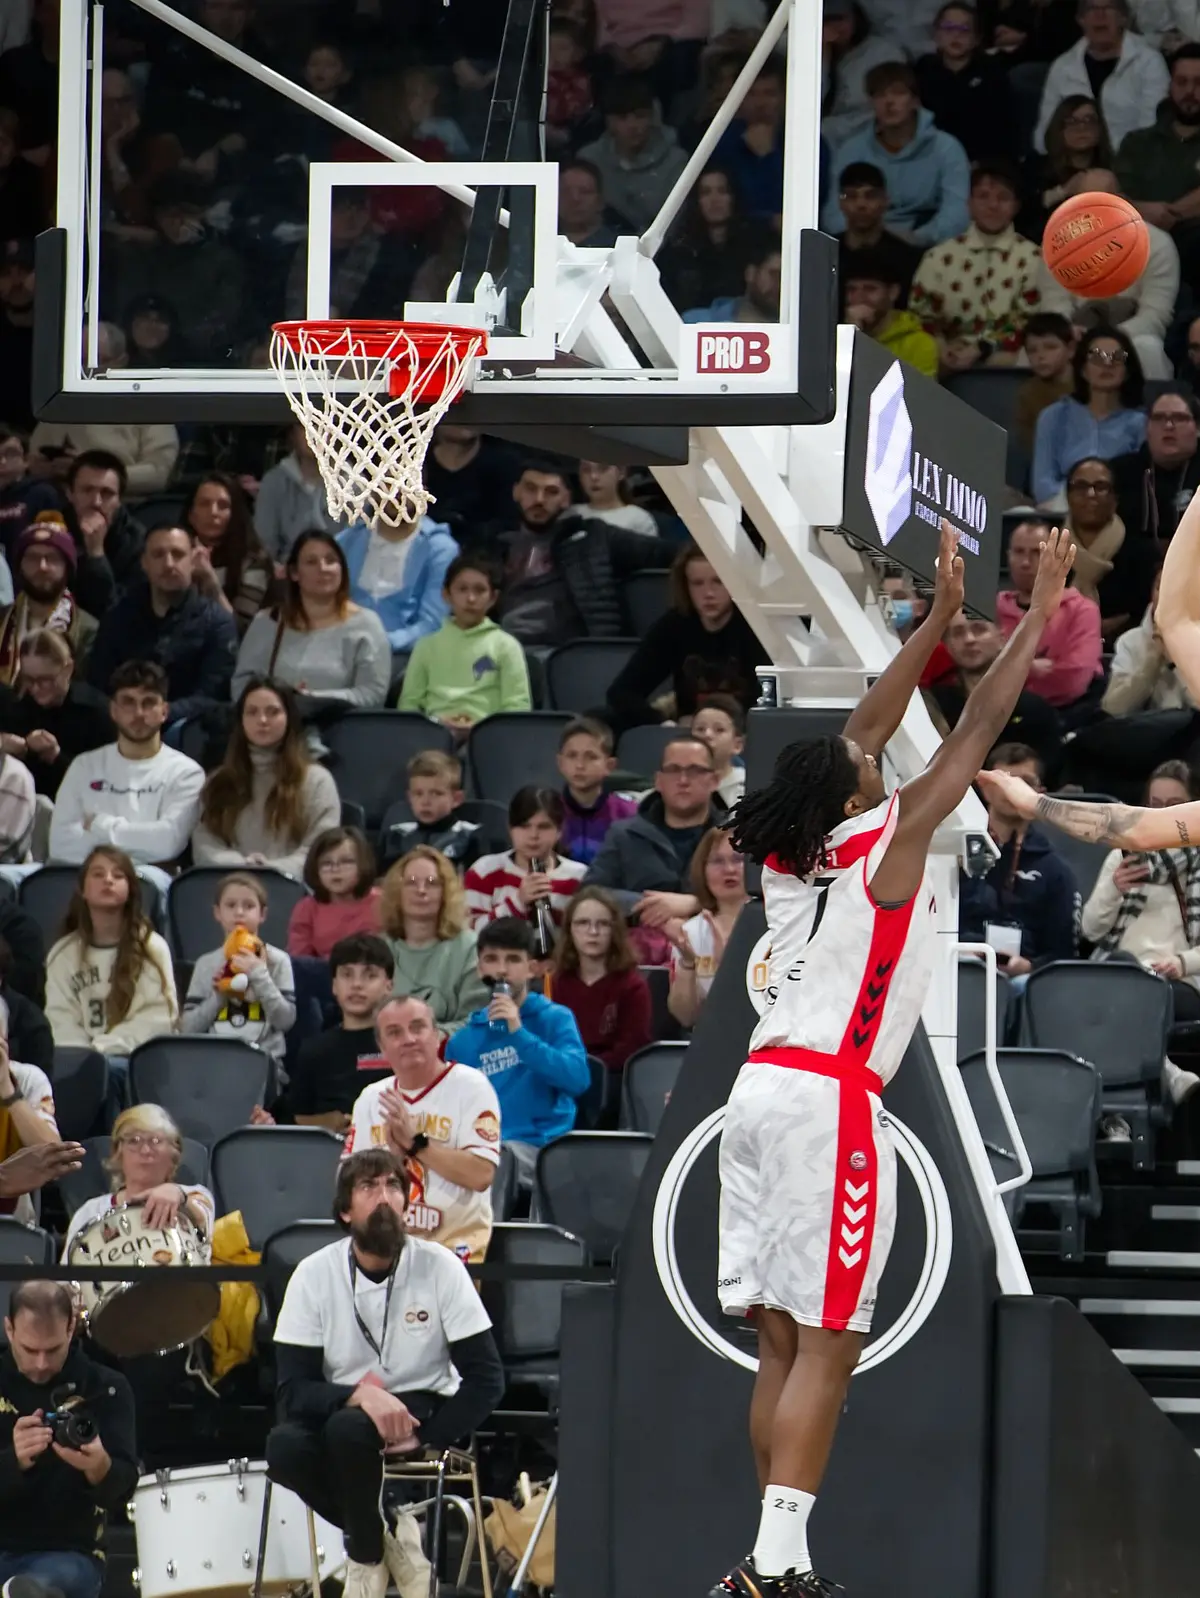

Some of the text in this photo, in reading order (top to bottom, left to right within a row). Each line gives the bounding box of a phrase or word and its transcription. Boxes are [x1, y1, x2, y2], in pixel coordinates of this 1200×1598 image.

[700, 336, 744, 370] PRO
[912, 452, 987, 534] LEX IMMO
[773, 1497, 798, 1512] 23
